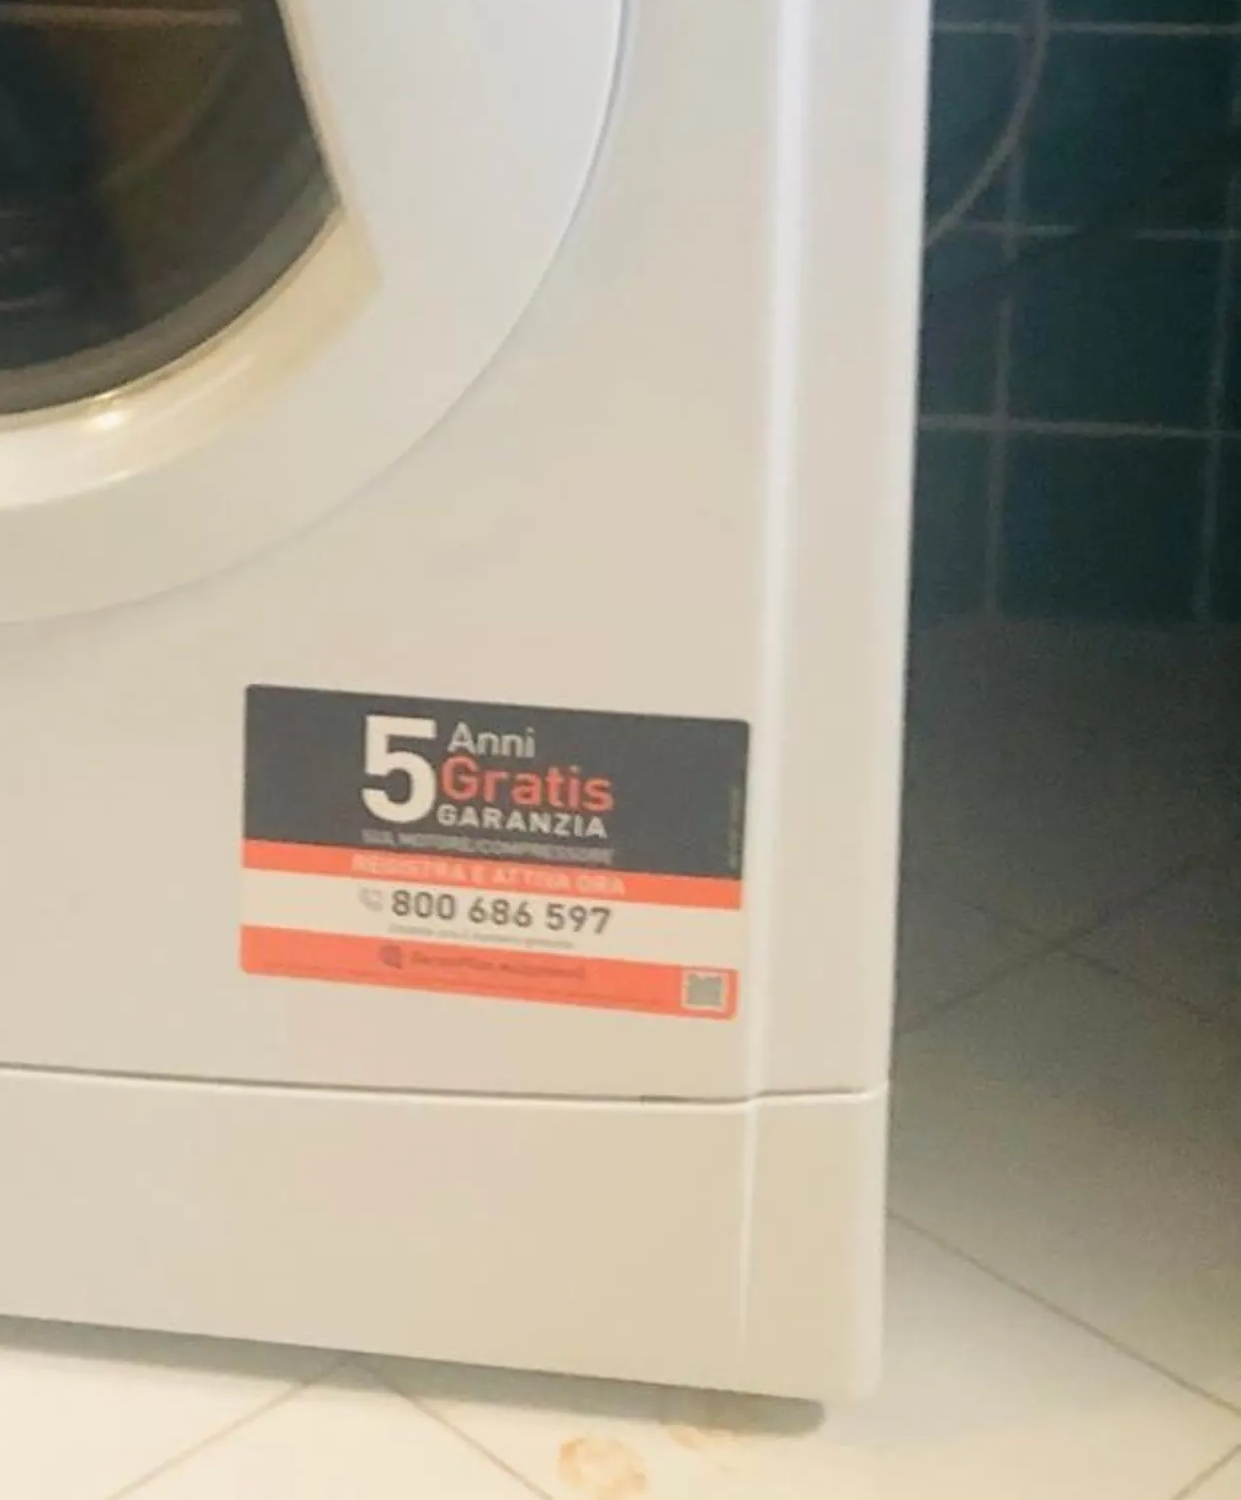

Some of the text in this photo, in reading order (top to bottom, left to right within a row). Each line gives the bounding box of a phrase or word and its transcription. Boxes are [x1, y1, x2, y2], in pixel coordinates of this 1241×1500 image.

[447, 722, 536, 759] Anni
[361, 714, 438, 824] 5
[439, 755, 616, 814] Gratis
[438, 805, 608, 839] GARANZIA
[391, 889, 613, 936] 800 686 597
